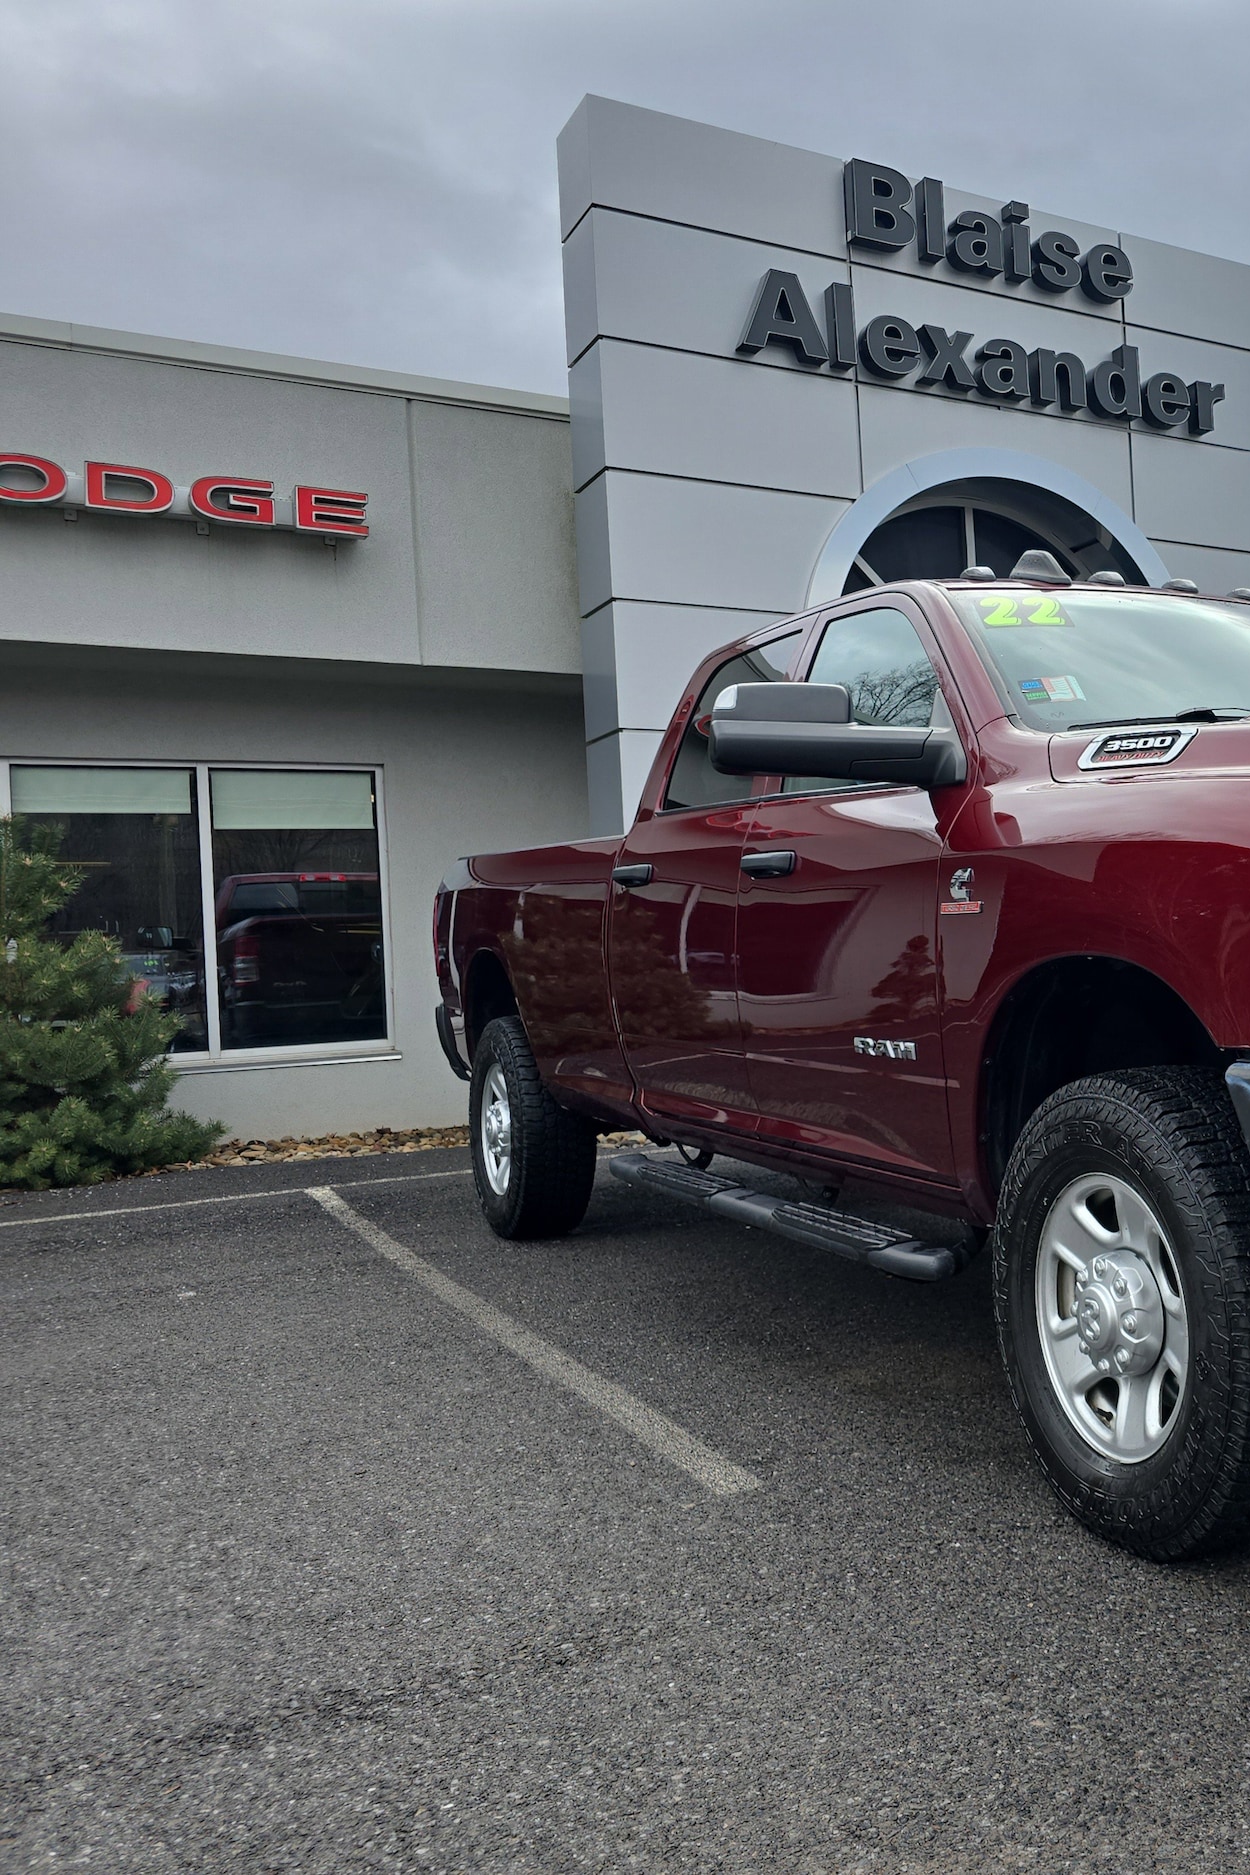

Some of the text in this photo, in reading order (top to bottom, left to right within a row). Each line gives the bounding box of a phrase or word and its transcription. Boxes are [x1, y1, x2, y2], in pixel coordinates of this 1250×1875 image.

[844, 157, 1134, 304] Blaise
[735, 269, 1225, 436] Alexander
[980, 597, 1065, 626] 22
[1104, 736, 1173, 752] 3500
[853, 1036, 917, 1061] RAM
